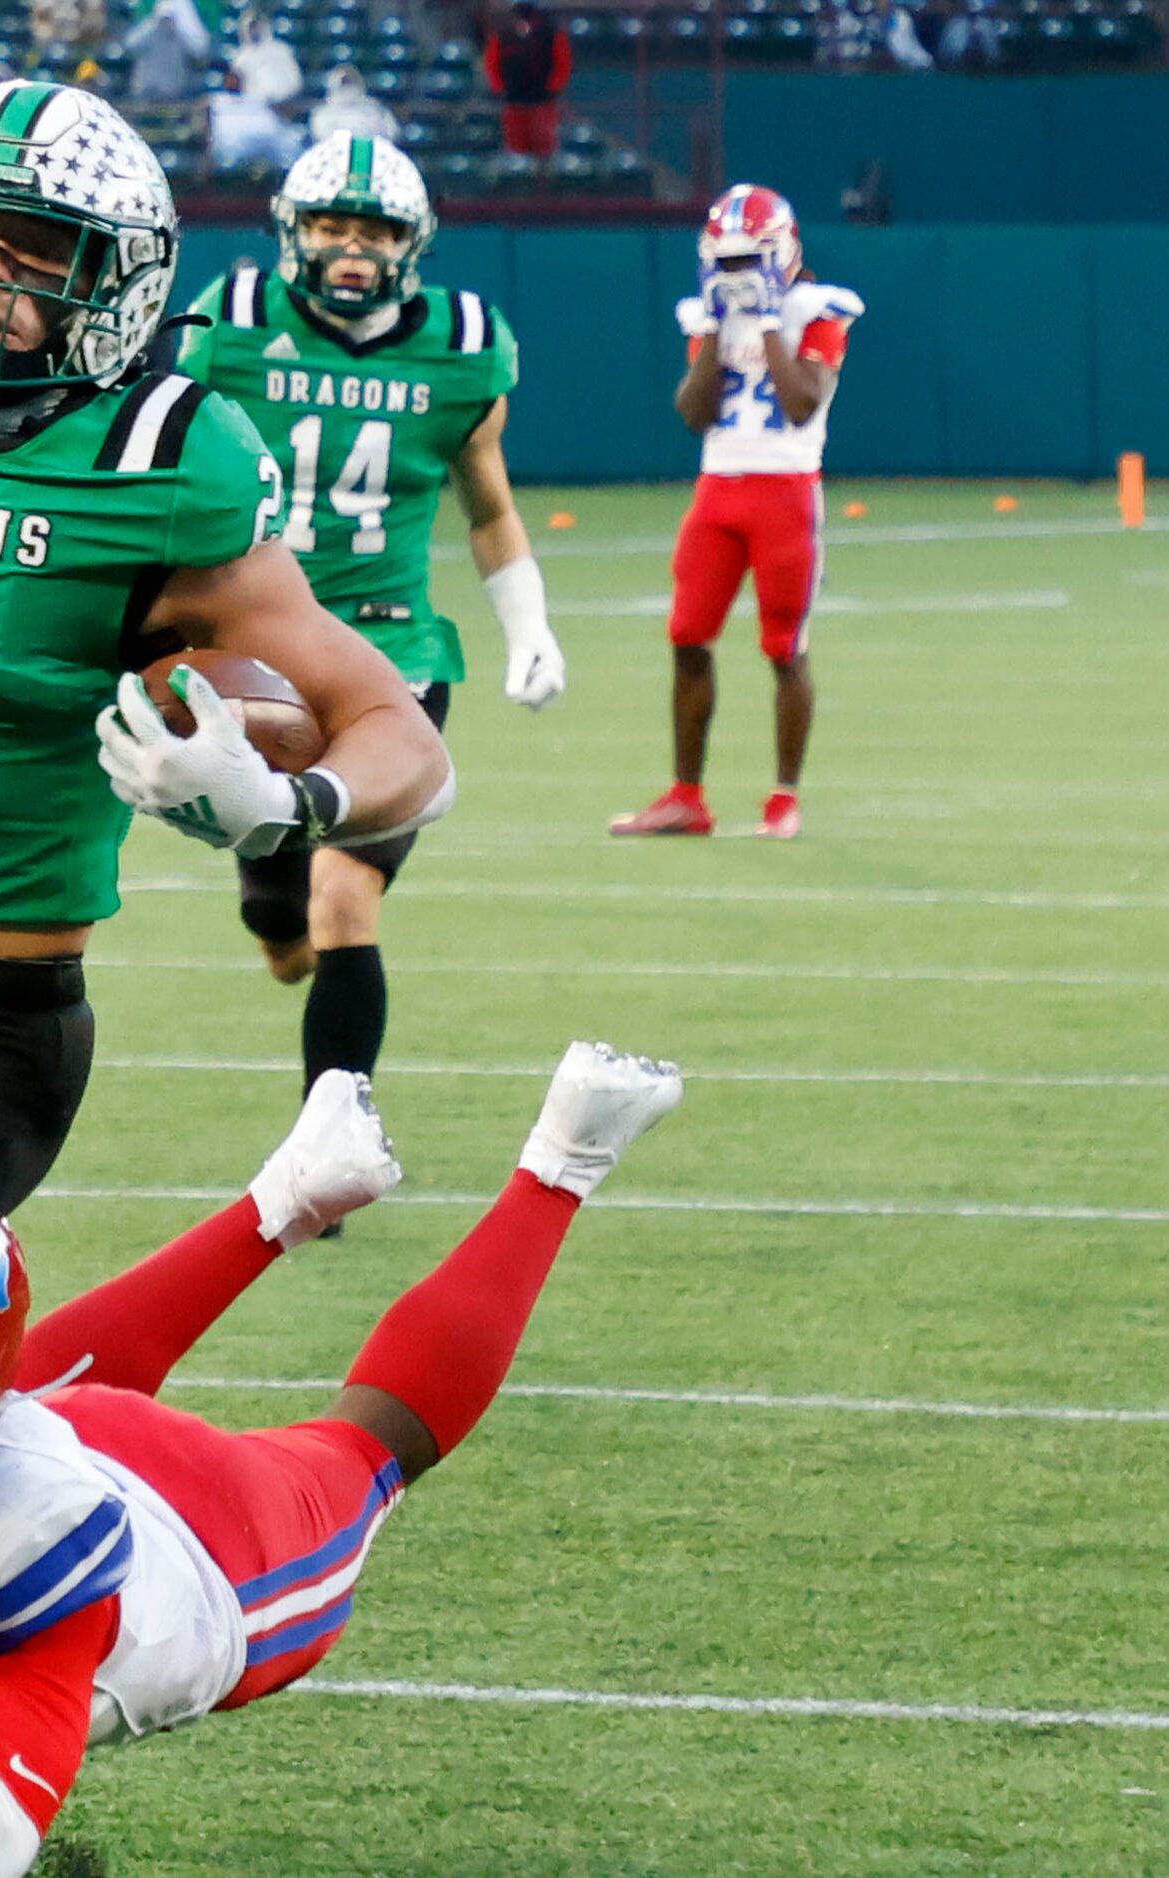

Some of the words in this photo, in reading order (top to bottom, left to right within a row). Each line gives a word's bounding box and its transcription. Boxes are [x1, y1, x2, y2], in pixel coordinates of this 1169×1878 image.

[266, 369, 431, 415] DRAGONS
[252, 455, 284, 544] 2
[282, 414, 392, 555] 14
